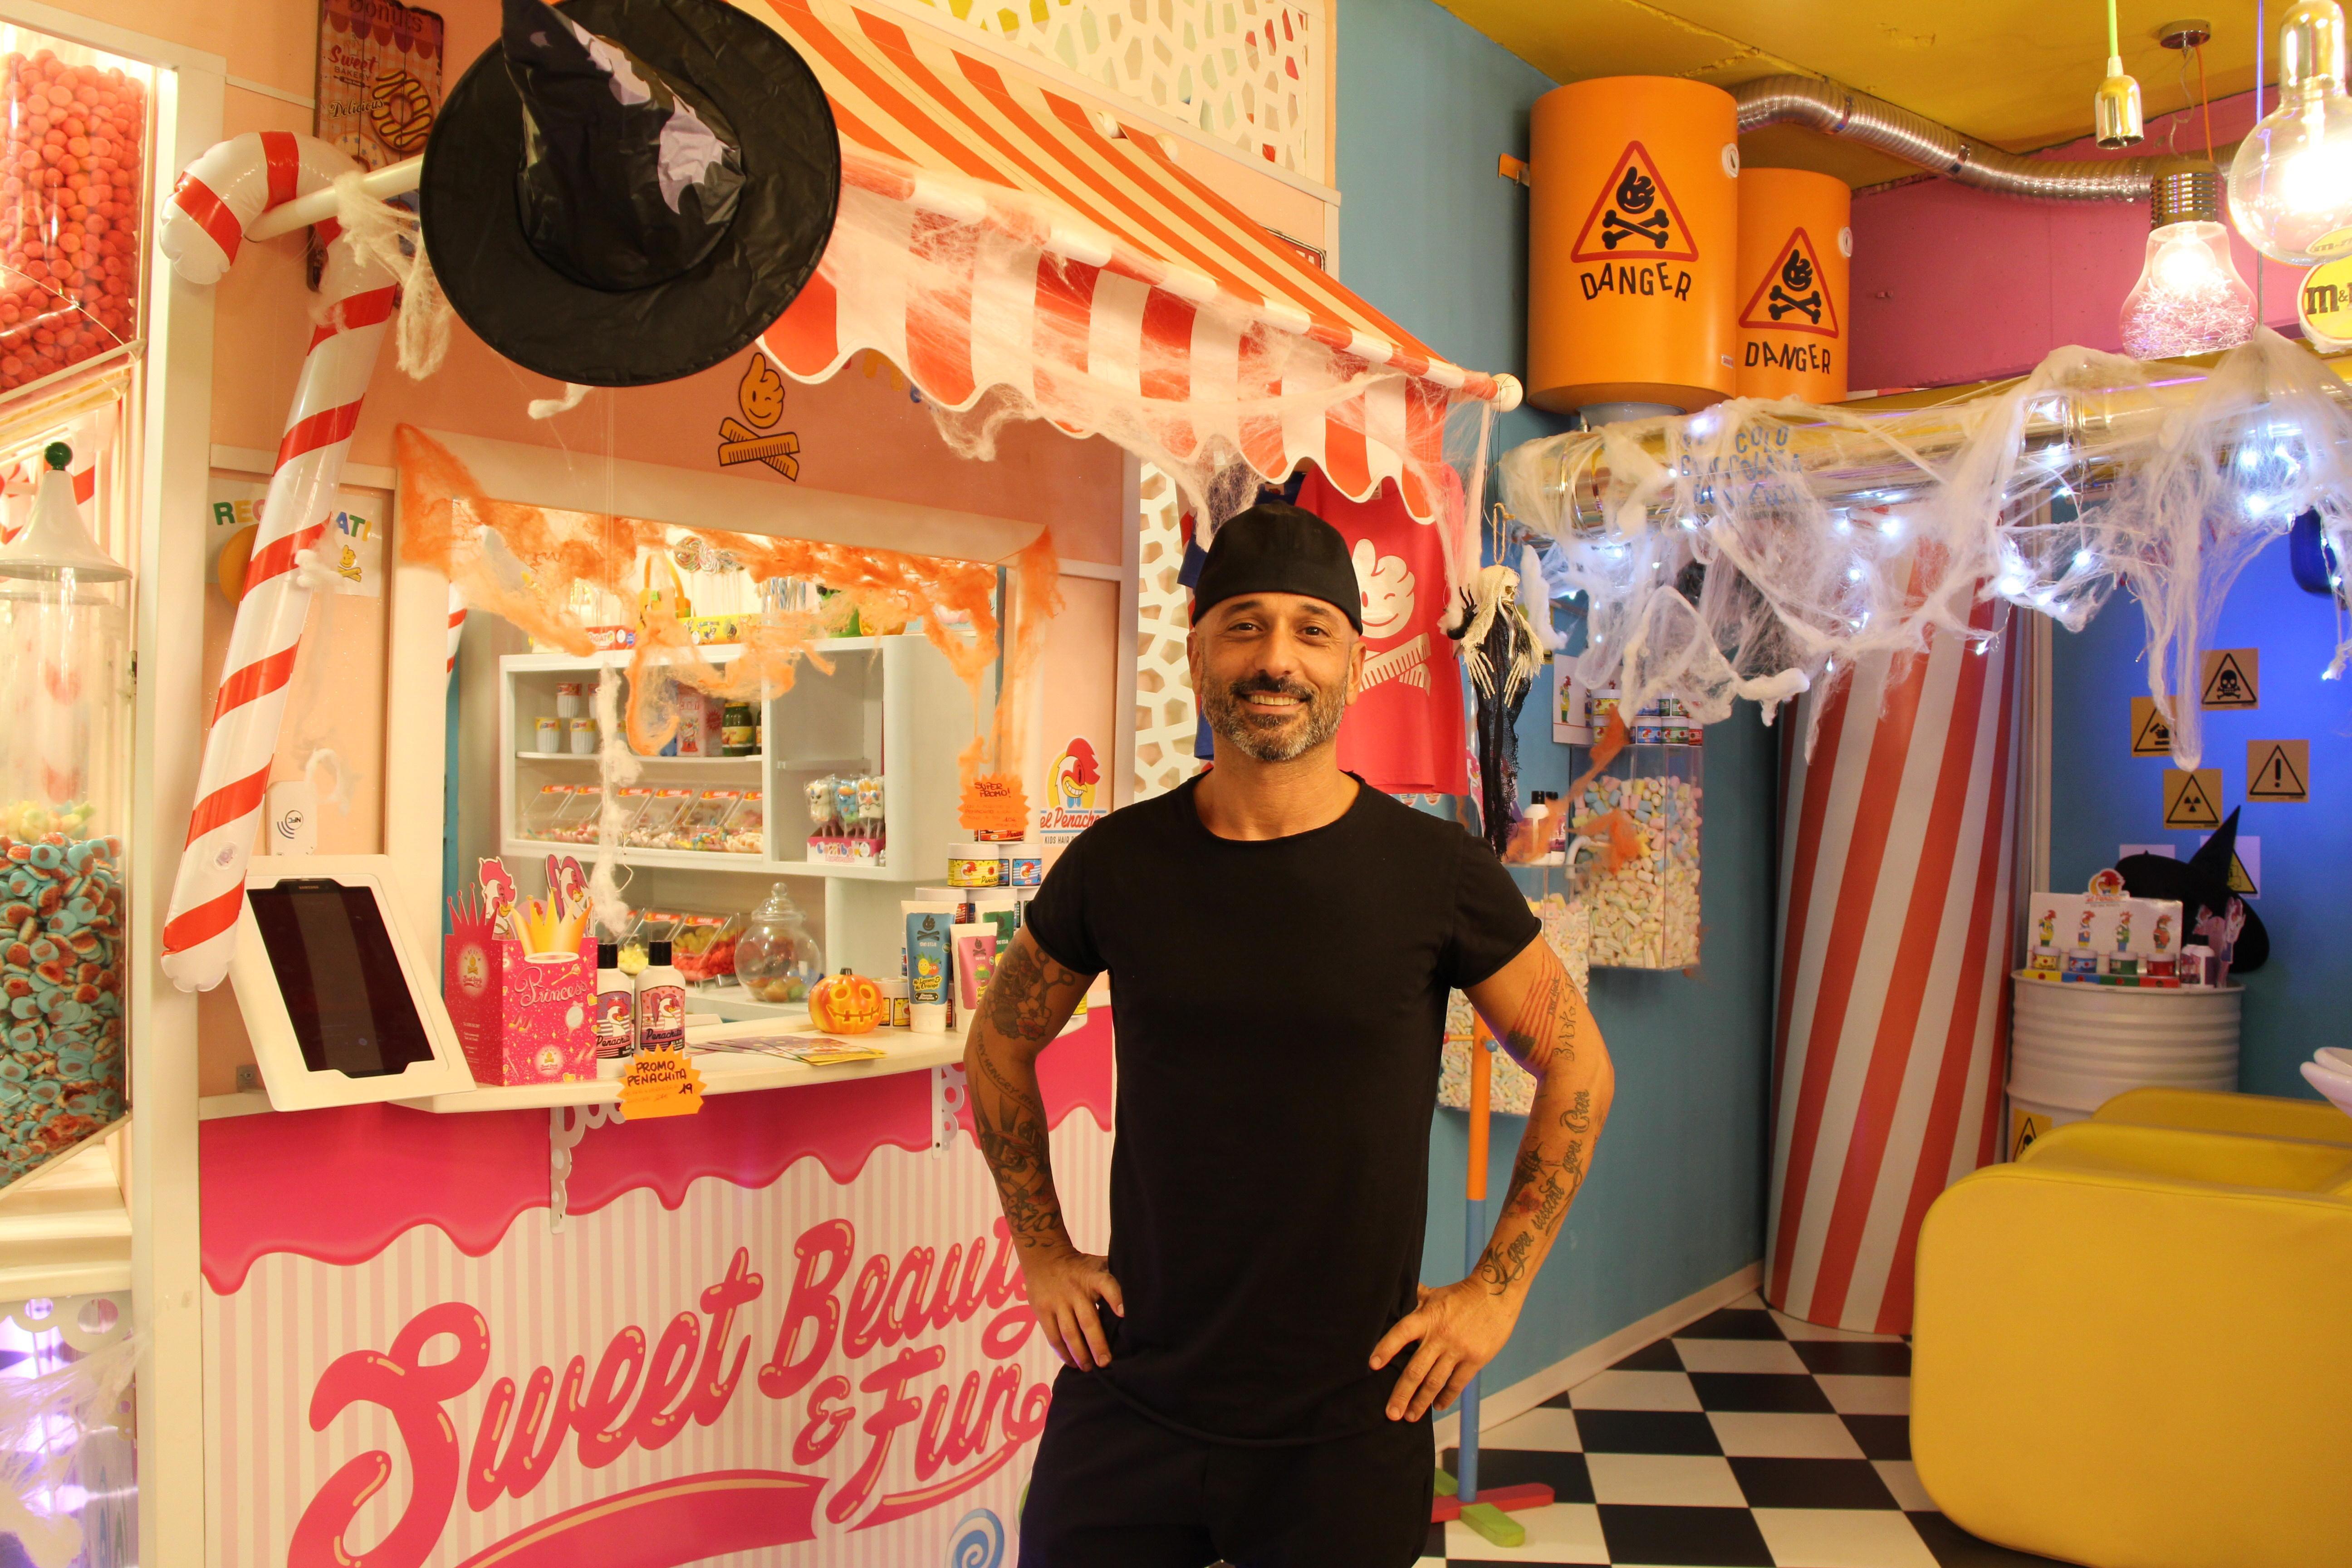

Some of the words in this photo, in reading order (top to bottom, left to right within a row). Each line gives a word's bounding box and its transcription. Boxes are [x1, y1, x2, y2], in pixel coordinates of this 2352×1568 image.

[328, 45, 377, 73] Sweet
[334, 66, 371, 81] BAKERY
[328, 98, 384, 119] Delicious
[1580, 262, 1692, 301] DANGER
[1744, 341, 1831, 374] DANGER
[974, 782, 1002, 790] SUPER
[980, 788, 1011, 798] PROMO!
[1040, 812, 1053, 828] el
[1054, 807, 1100, 828] Penach
[1058, 836, 1069, 844] HAIR
[514, 965, 588, 1007] Princess
[646, 1028, 682, 1040] Penachita
[636, 1061, 675, 1073] PROMO
[286, 1247, 763, 1568] Sweet
[792, 1375, 856, 1466] &
[825, 1344, 1052, 1524] Fun
